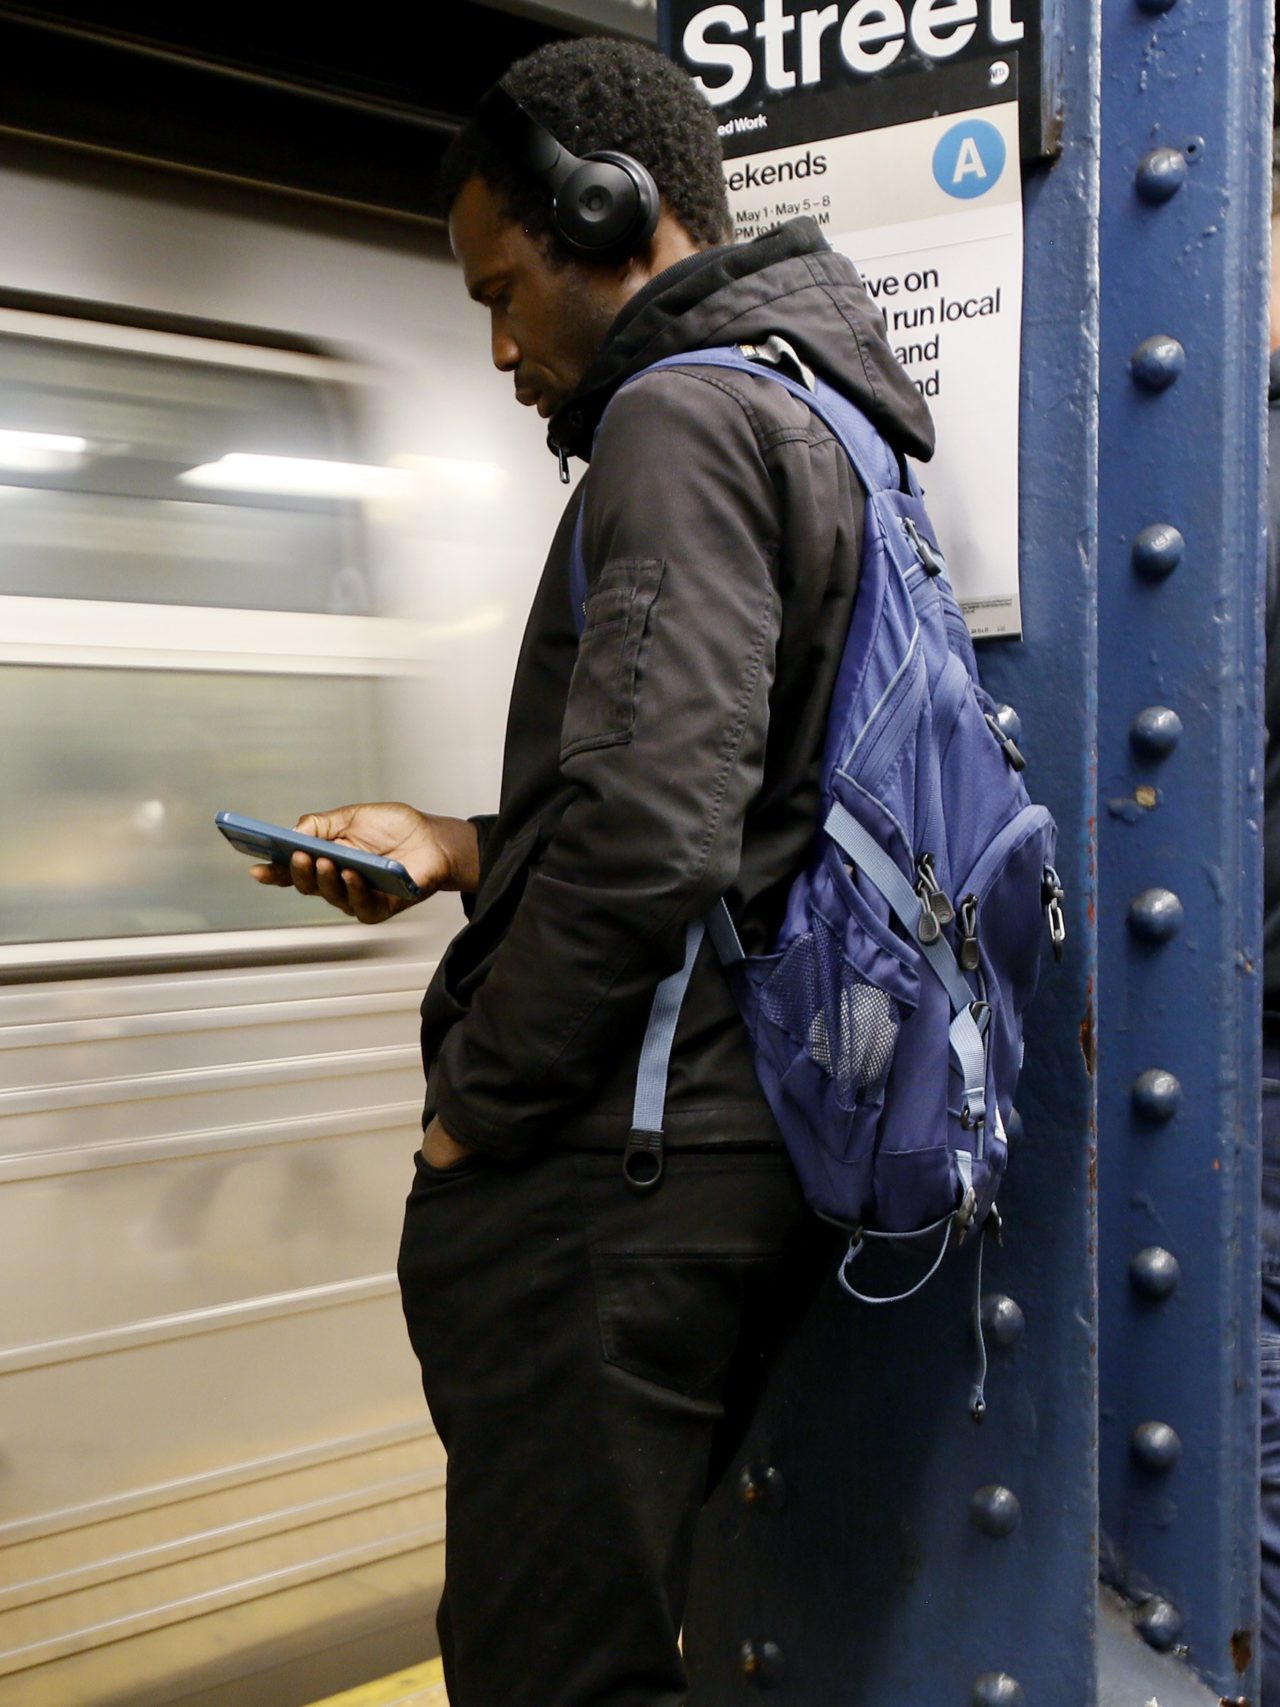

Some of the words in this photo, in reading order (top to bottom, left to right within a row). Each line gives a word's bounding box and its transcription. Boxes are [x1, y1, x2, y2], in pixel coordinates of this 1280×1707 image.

[734, 113, 767, 132] Work
[725, 150, 827, 191] ekends
[952, 136, 987, 183] A
[736, 209, 760, 223] May
[763, 206, 768, 218] 1
[775, 202, 801, 216] May
[735, 225, 754, 239] PM
[904, 268, 939, 292] on
[894, 305, 934, 331] run
[940, 287, 1001, 323] local
[894, 333, 940, 365] and
